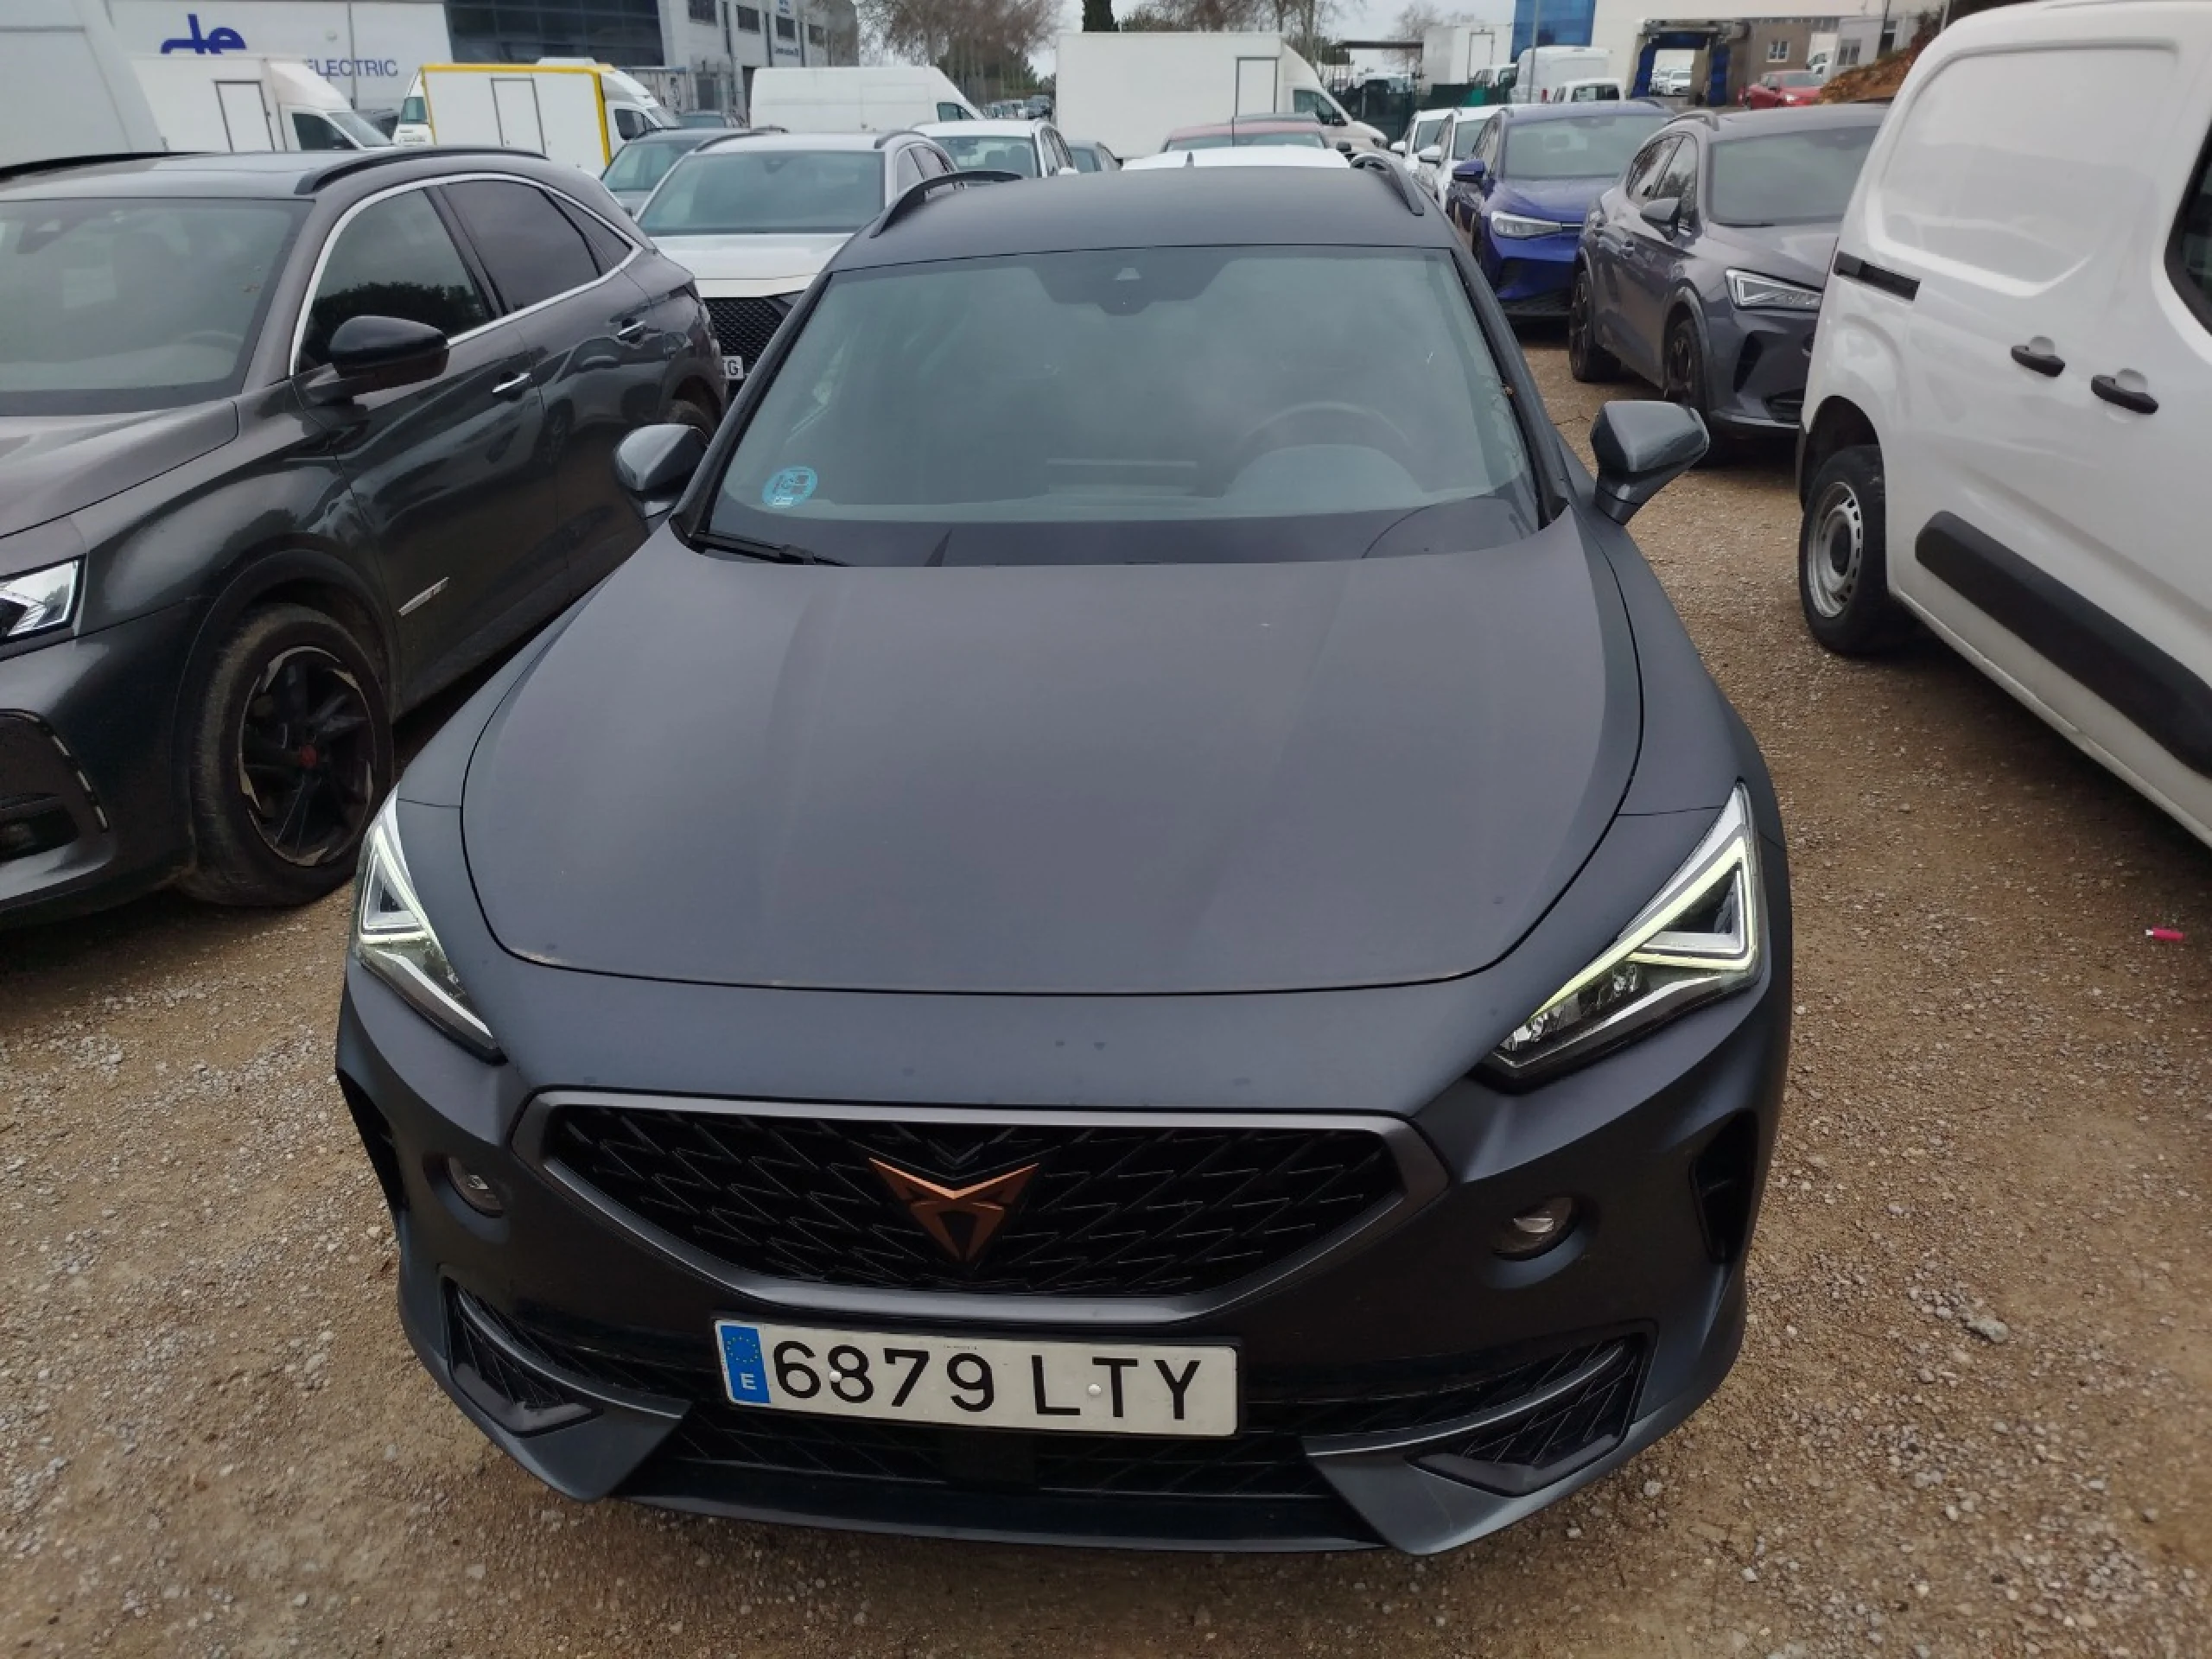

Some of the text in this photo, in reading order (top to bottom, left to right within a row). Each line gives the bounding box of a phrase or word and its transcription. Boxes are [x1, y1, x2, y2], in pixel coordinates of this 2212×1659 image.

[741, 1340, 1200, 1420] E 6879 LTY
